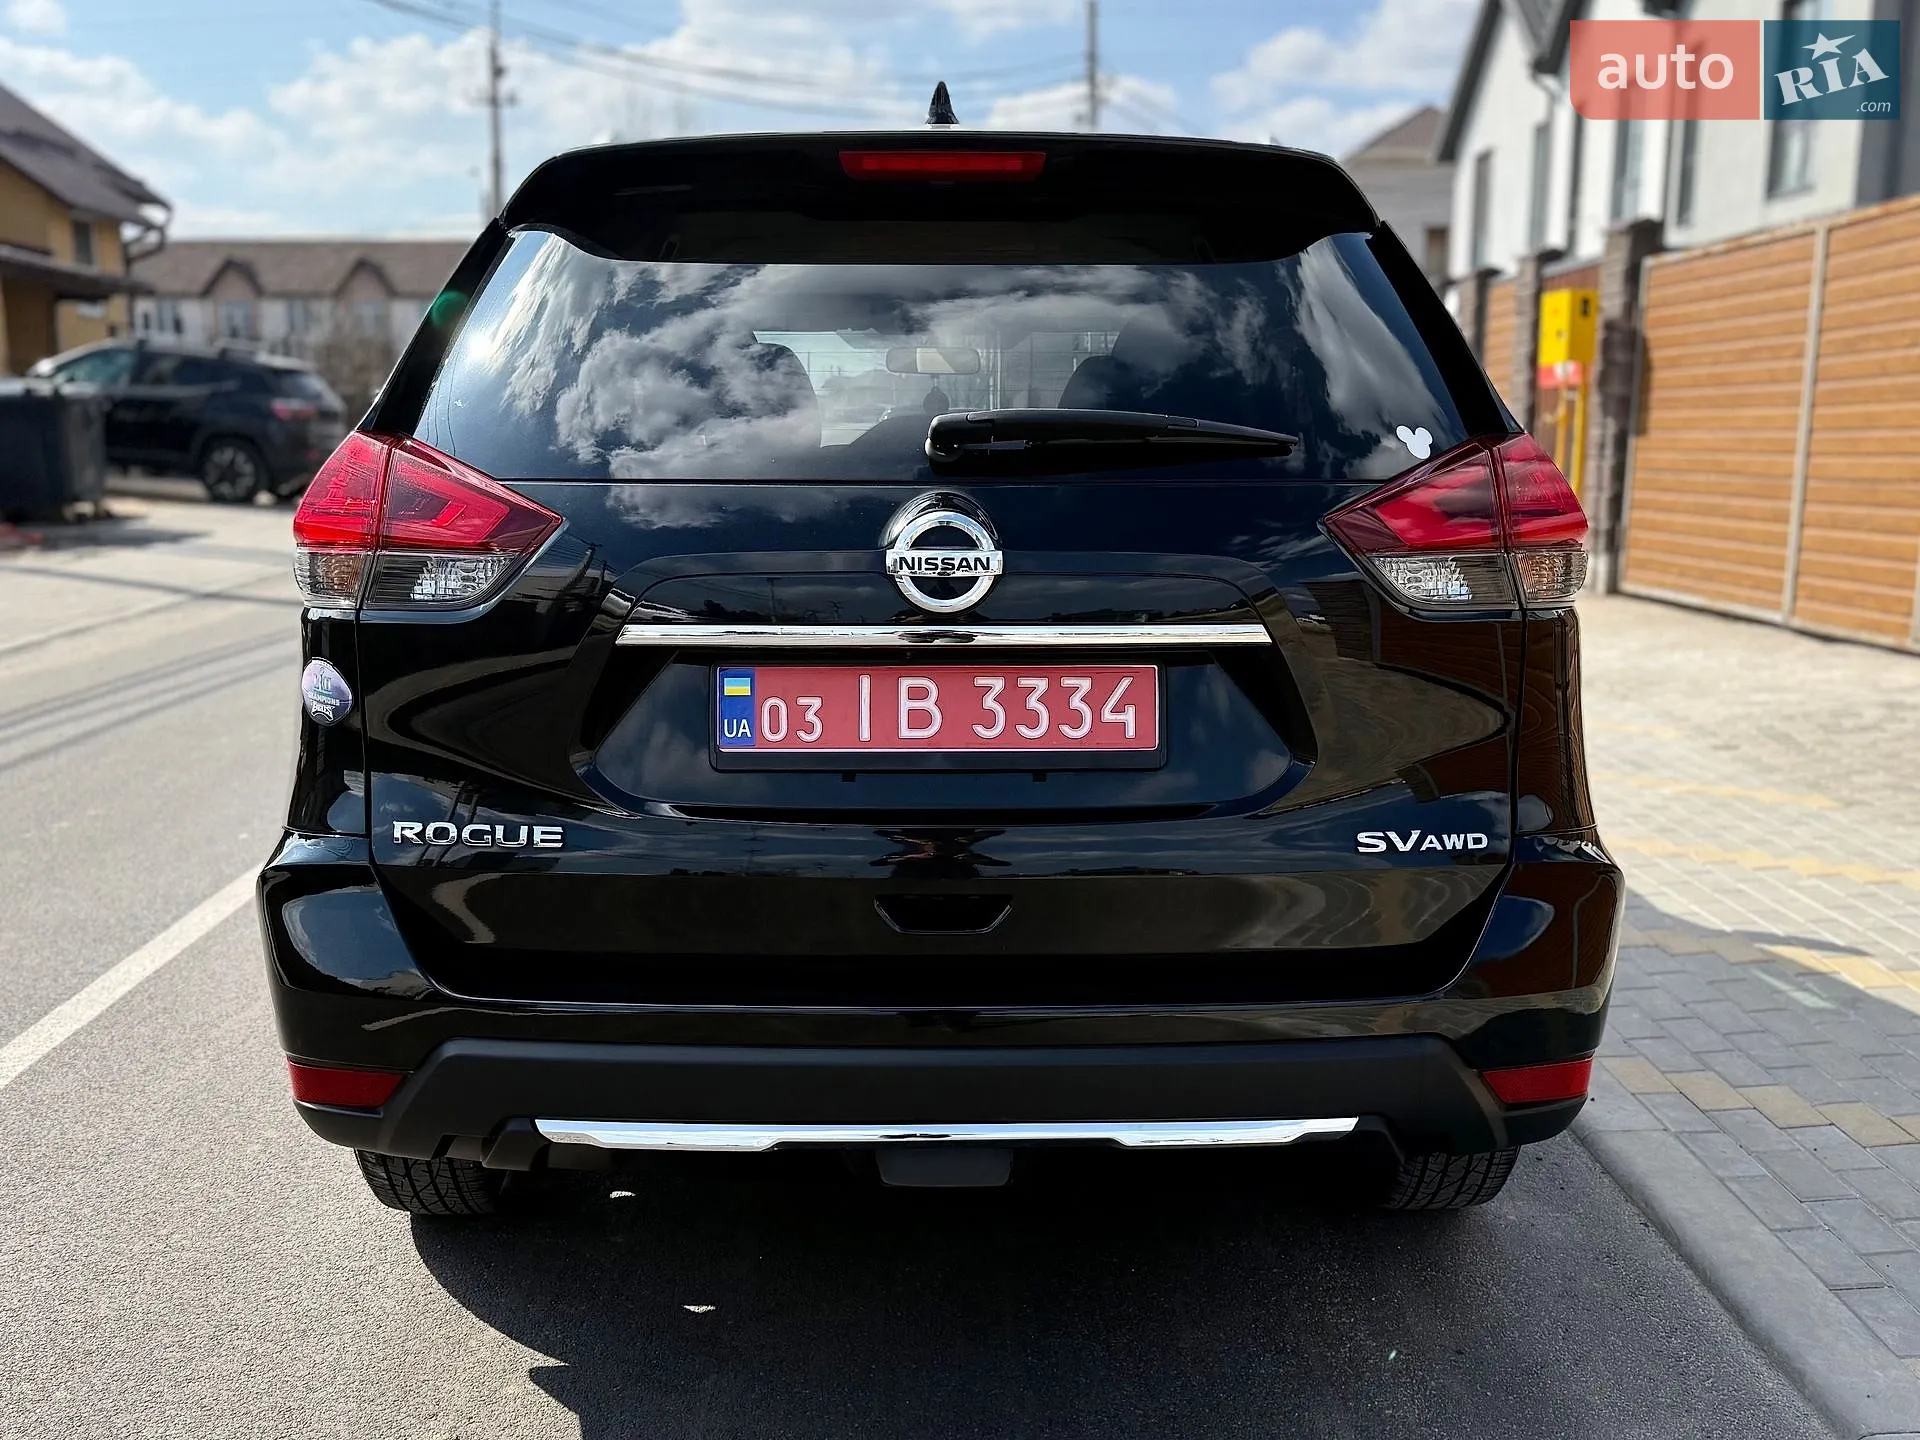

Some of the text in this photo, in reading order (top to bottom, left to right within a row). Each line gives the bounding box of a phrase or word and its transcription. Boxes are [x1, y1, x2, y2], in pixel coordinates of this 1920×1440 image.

[898, 556, 991, 572] NISSAN
[760, 696, 824, 743] 03
[971, 676, 1137, 740] 3334
[723, 718, 752, 739] UA
[392, 820, 564, 848] ROGUE
